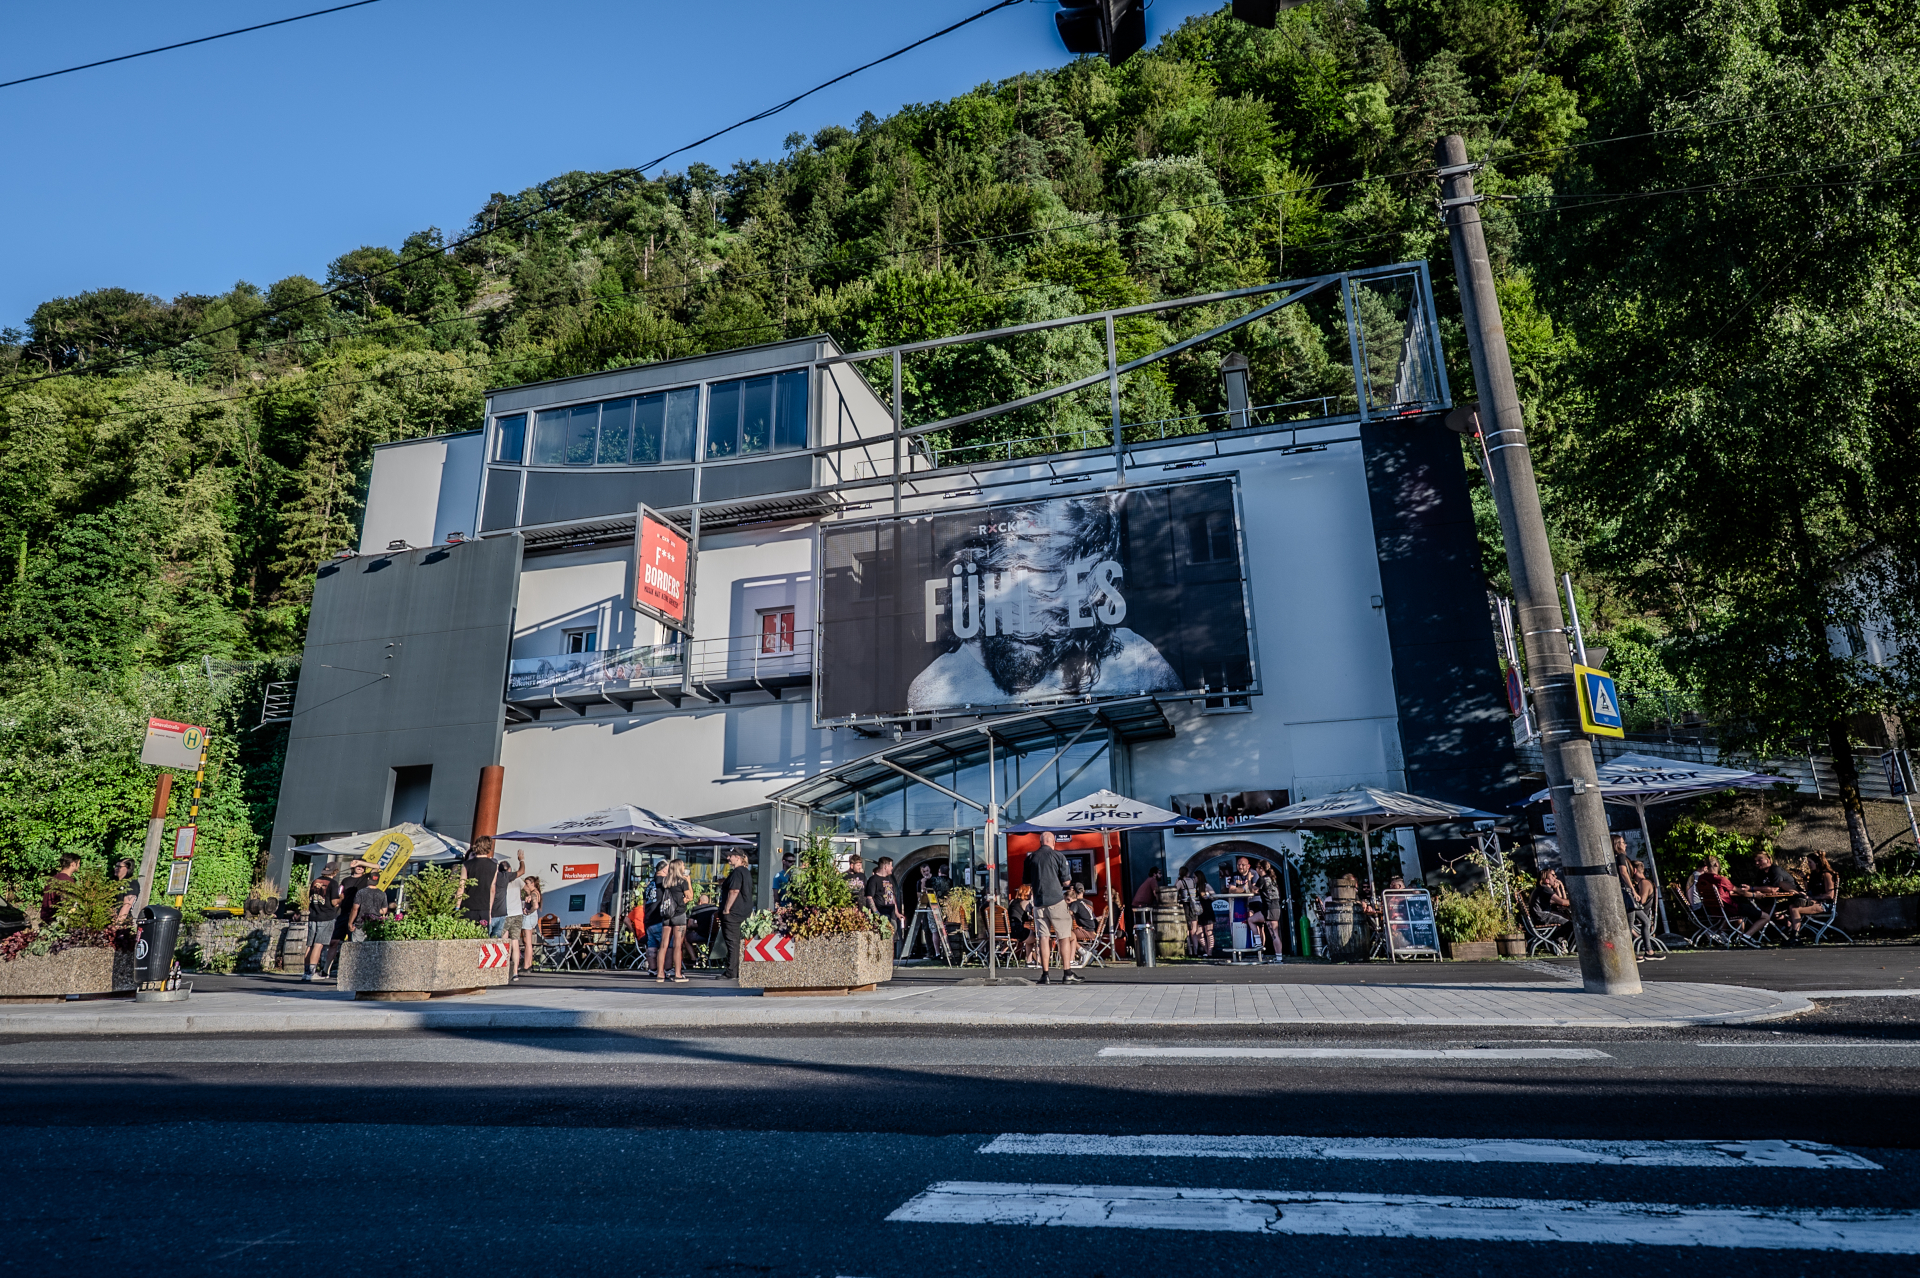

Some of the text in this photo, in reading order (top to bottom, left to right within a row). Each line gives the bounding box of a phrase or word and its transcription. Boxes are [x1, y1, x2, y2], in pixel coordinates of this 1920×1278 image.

[644, 563, 681, 600] BORDERS
[925, 560, 1127, 643] FÜHL ES
[1606, 771, 1700, 786] Zipfer
[1066, 809, 1143, 822] Zipfer
[1288, 802, 1358, 815] Zipfer
[377, 843, 399, 870] CLUB
[563, 872, 597, 880] Workshopraum
